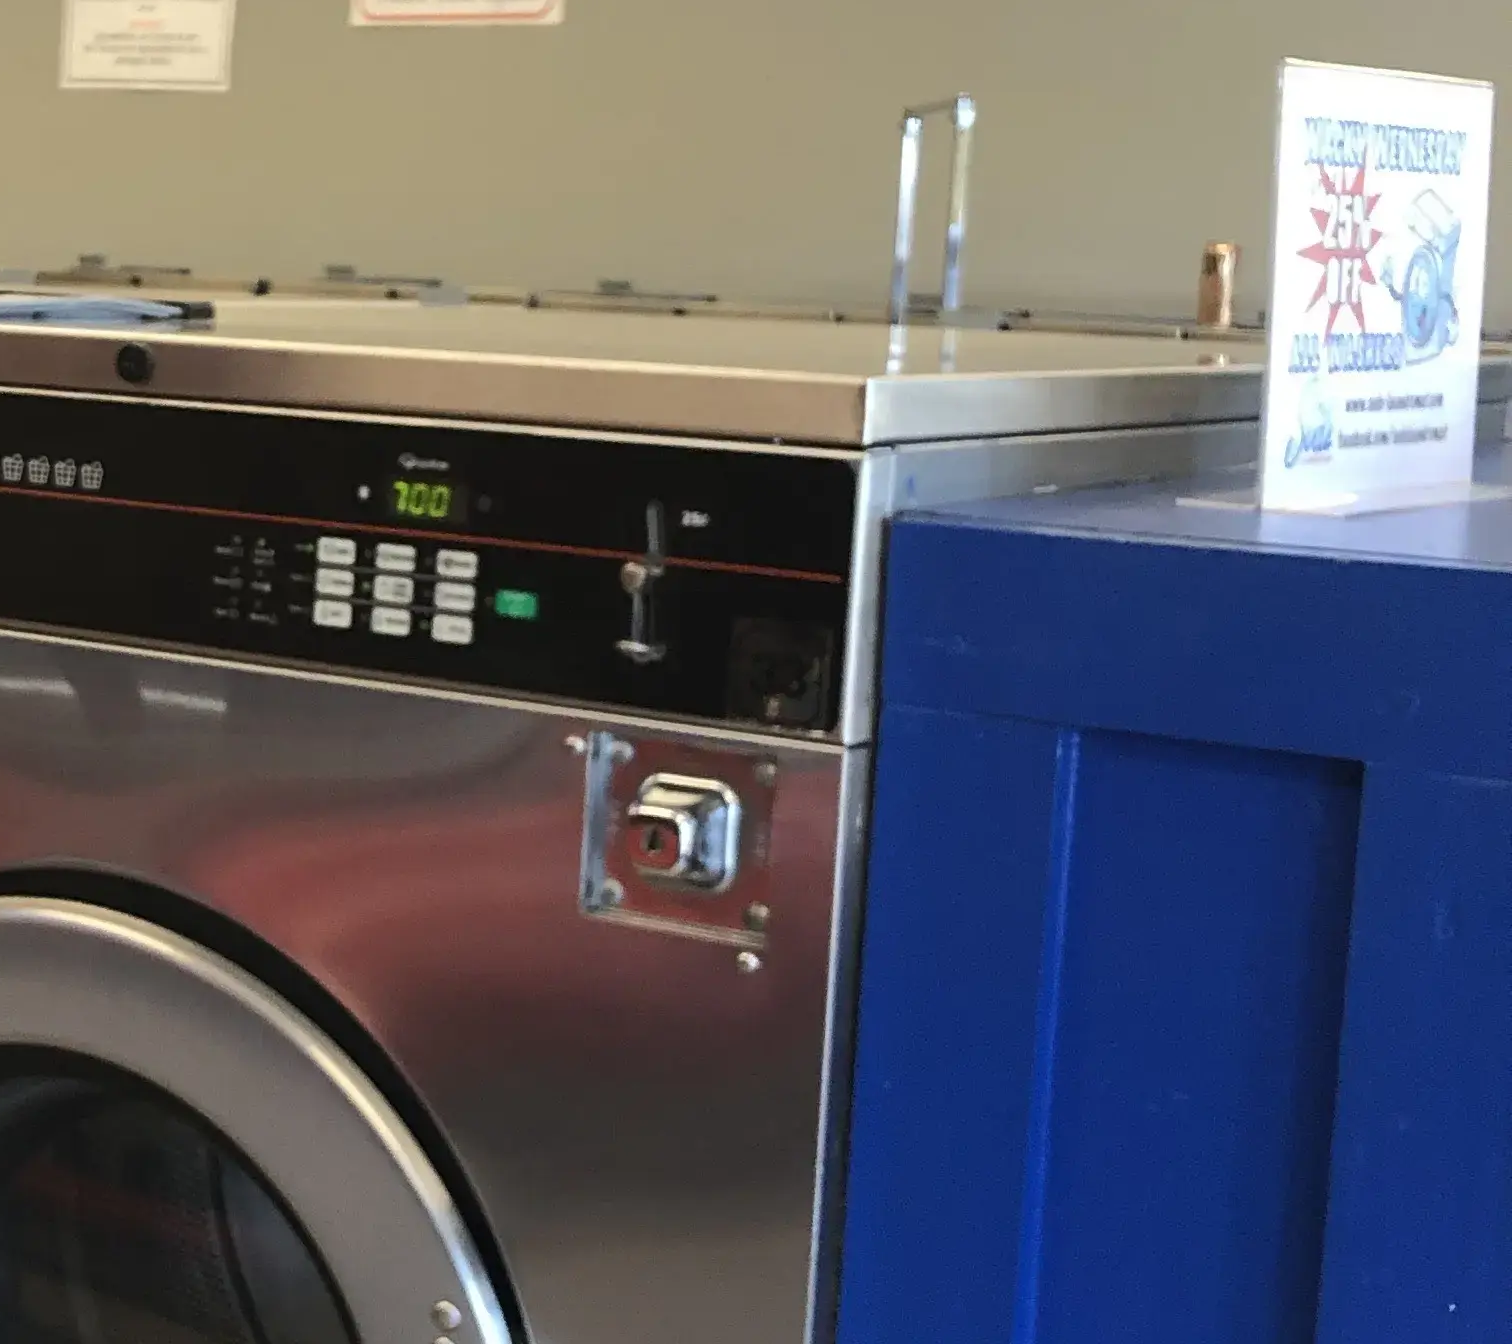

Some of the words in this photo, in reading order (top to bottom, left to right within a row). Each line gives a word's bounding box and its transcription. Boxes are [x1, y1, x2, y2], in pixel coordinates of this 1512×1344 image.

[1304, 116, 1370, 168] WACKY
[1373, 123, 1466, 176] WEDNESDAY
[1323, 193, 1372, 250] 25%
[1325, 256, 1363, 305] OFF
